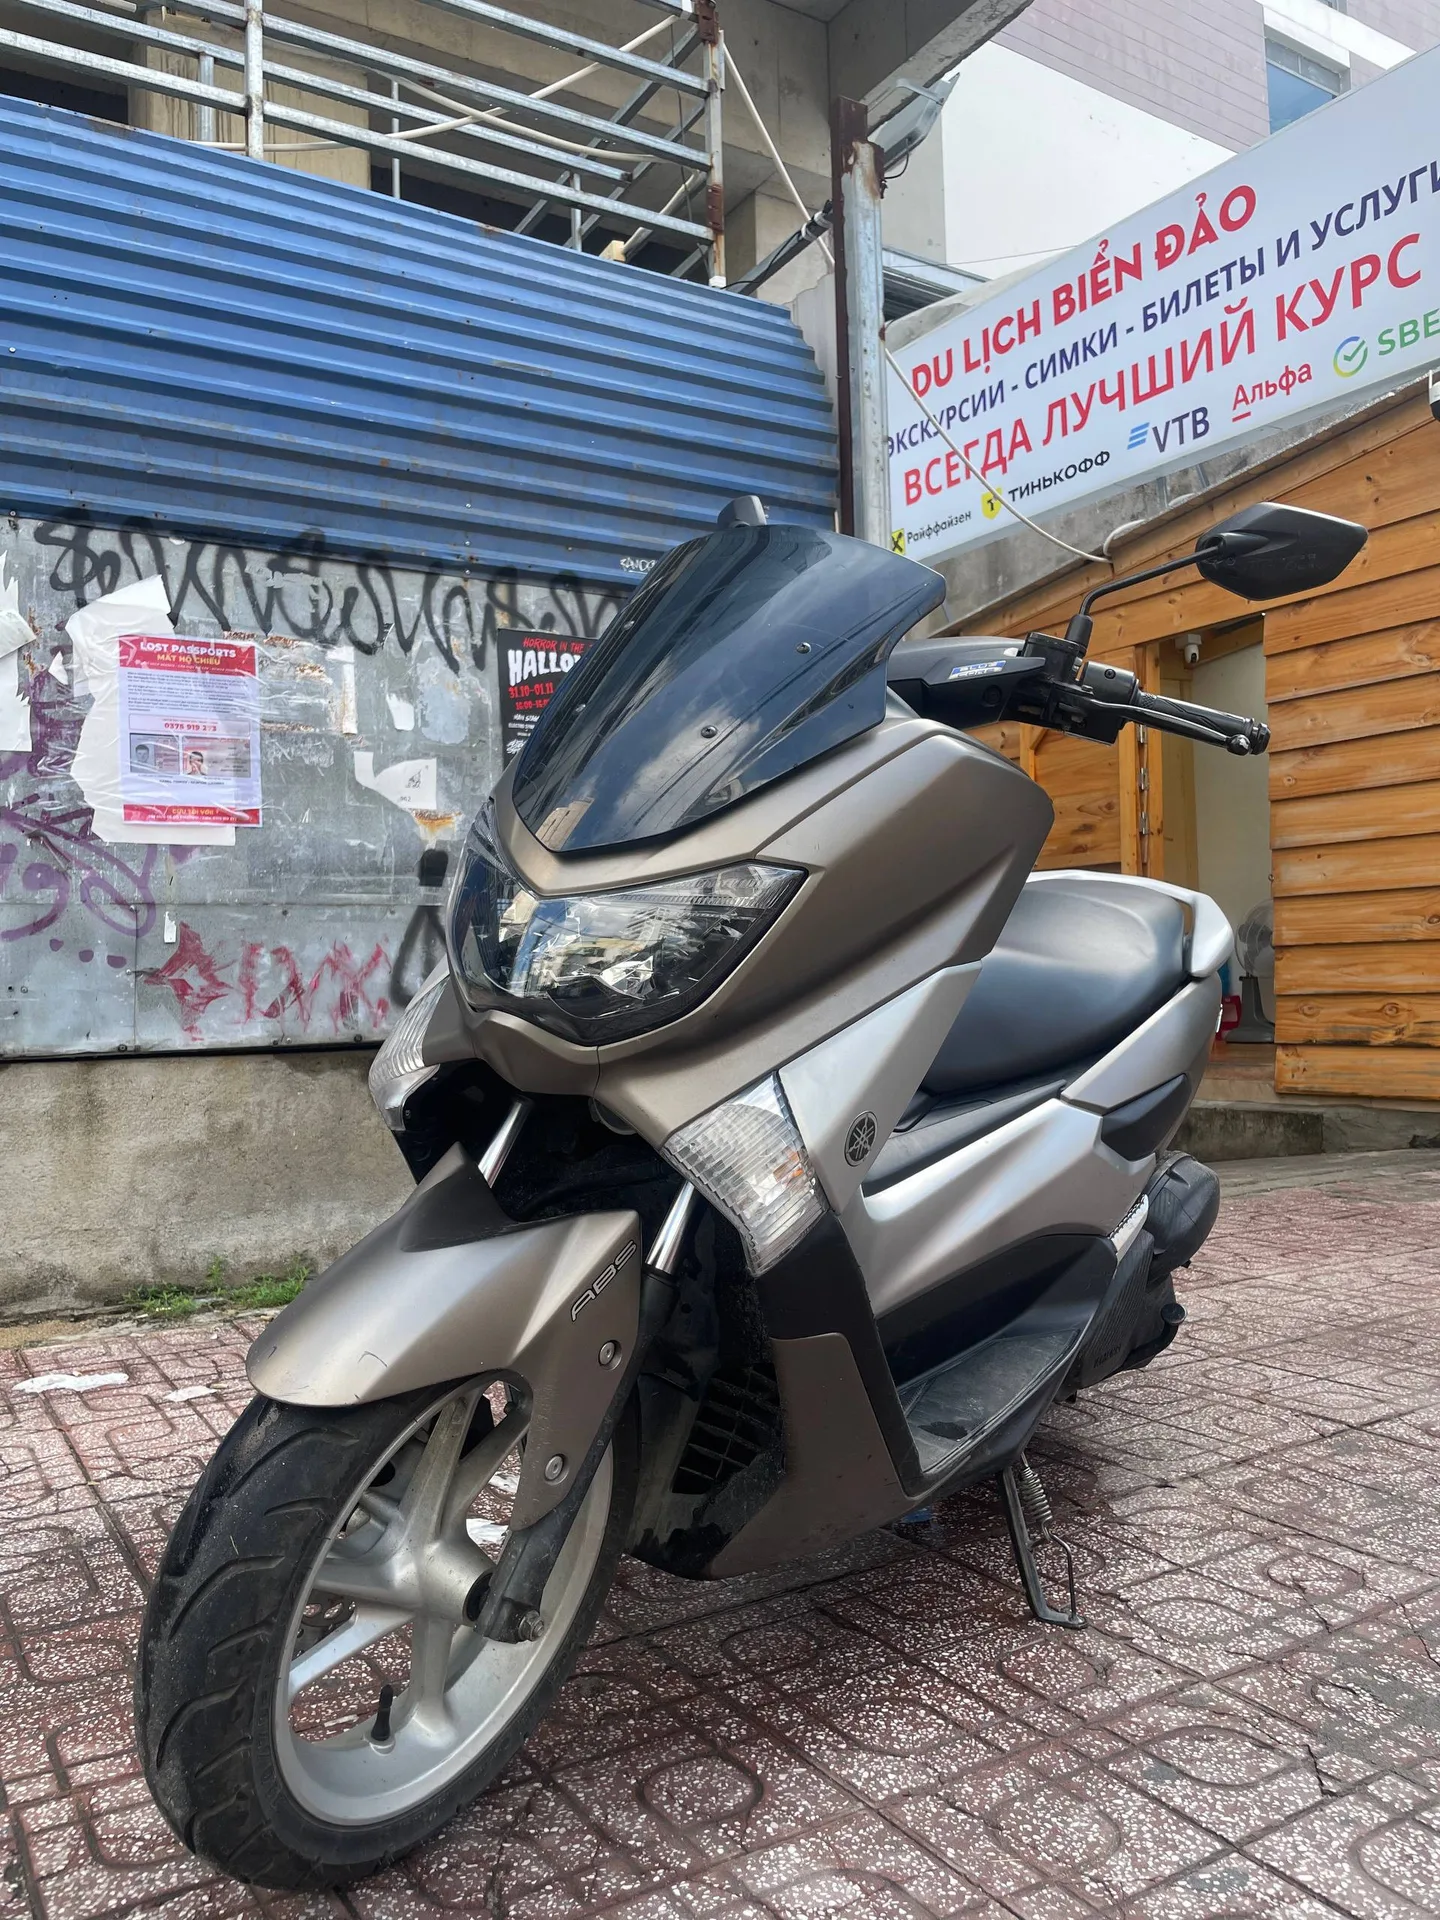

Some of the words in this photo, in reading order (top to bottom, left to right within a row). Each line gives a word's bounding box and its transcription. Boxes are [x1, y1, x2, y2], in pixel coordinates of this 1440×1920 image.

[911, 348, 954, 398] DU
[963, 300, 1043, 375] LỊCH
[1052, 238, 1143, 327] BIỂN
[1154, 185, 1257, 272] ĐẢO
[1025, 321, 1118, 390] СИМКИ
[1142, 246, 1265, 333] БИЛЕТЫ
[1276, 229, 1301, 268] И
[903, 417, 1033, 507] ВСЕГДА
[1042, 296, 1256, 447] ЛУЧШИЙ
[1275, 232, 1422, 342] КУРС
[1231, 362, 1313, 412] Альфа
[1151, 405, 1211, 454] VTB
[1007, 450, 1111, 503] ТИНЬКОФФ
[906, 510, 972, 545] Райффайзен
[139, 641, 169, 652] LOST
[171, 643, 237, 658] PASSPORTS
[522, 637, 558, 652] HORROR
[559, 641, 568, 652] IN
[570, 642, 585, 653] THE
[507, 682, 554, 699] 31.10-01.11
[571, 1239, 637, 1322] ABS
